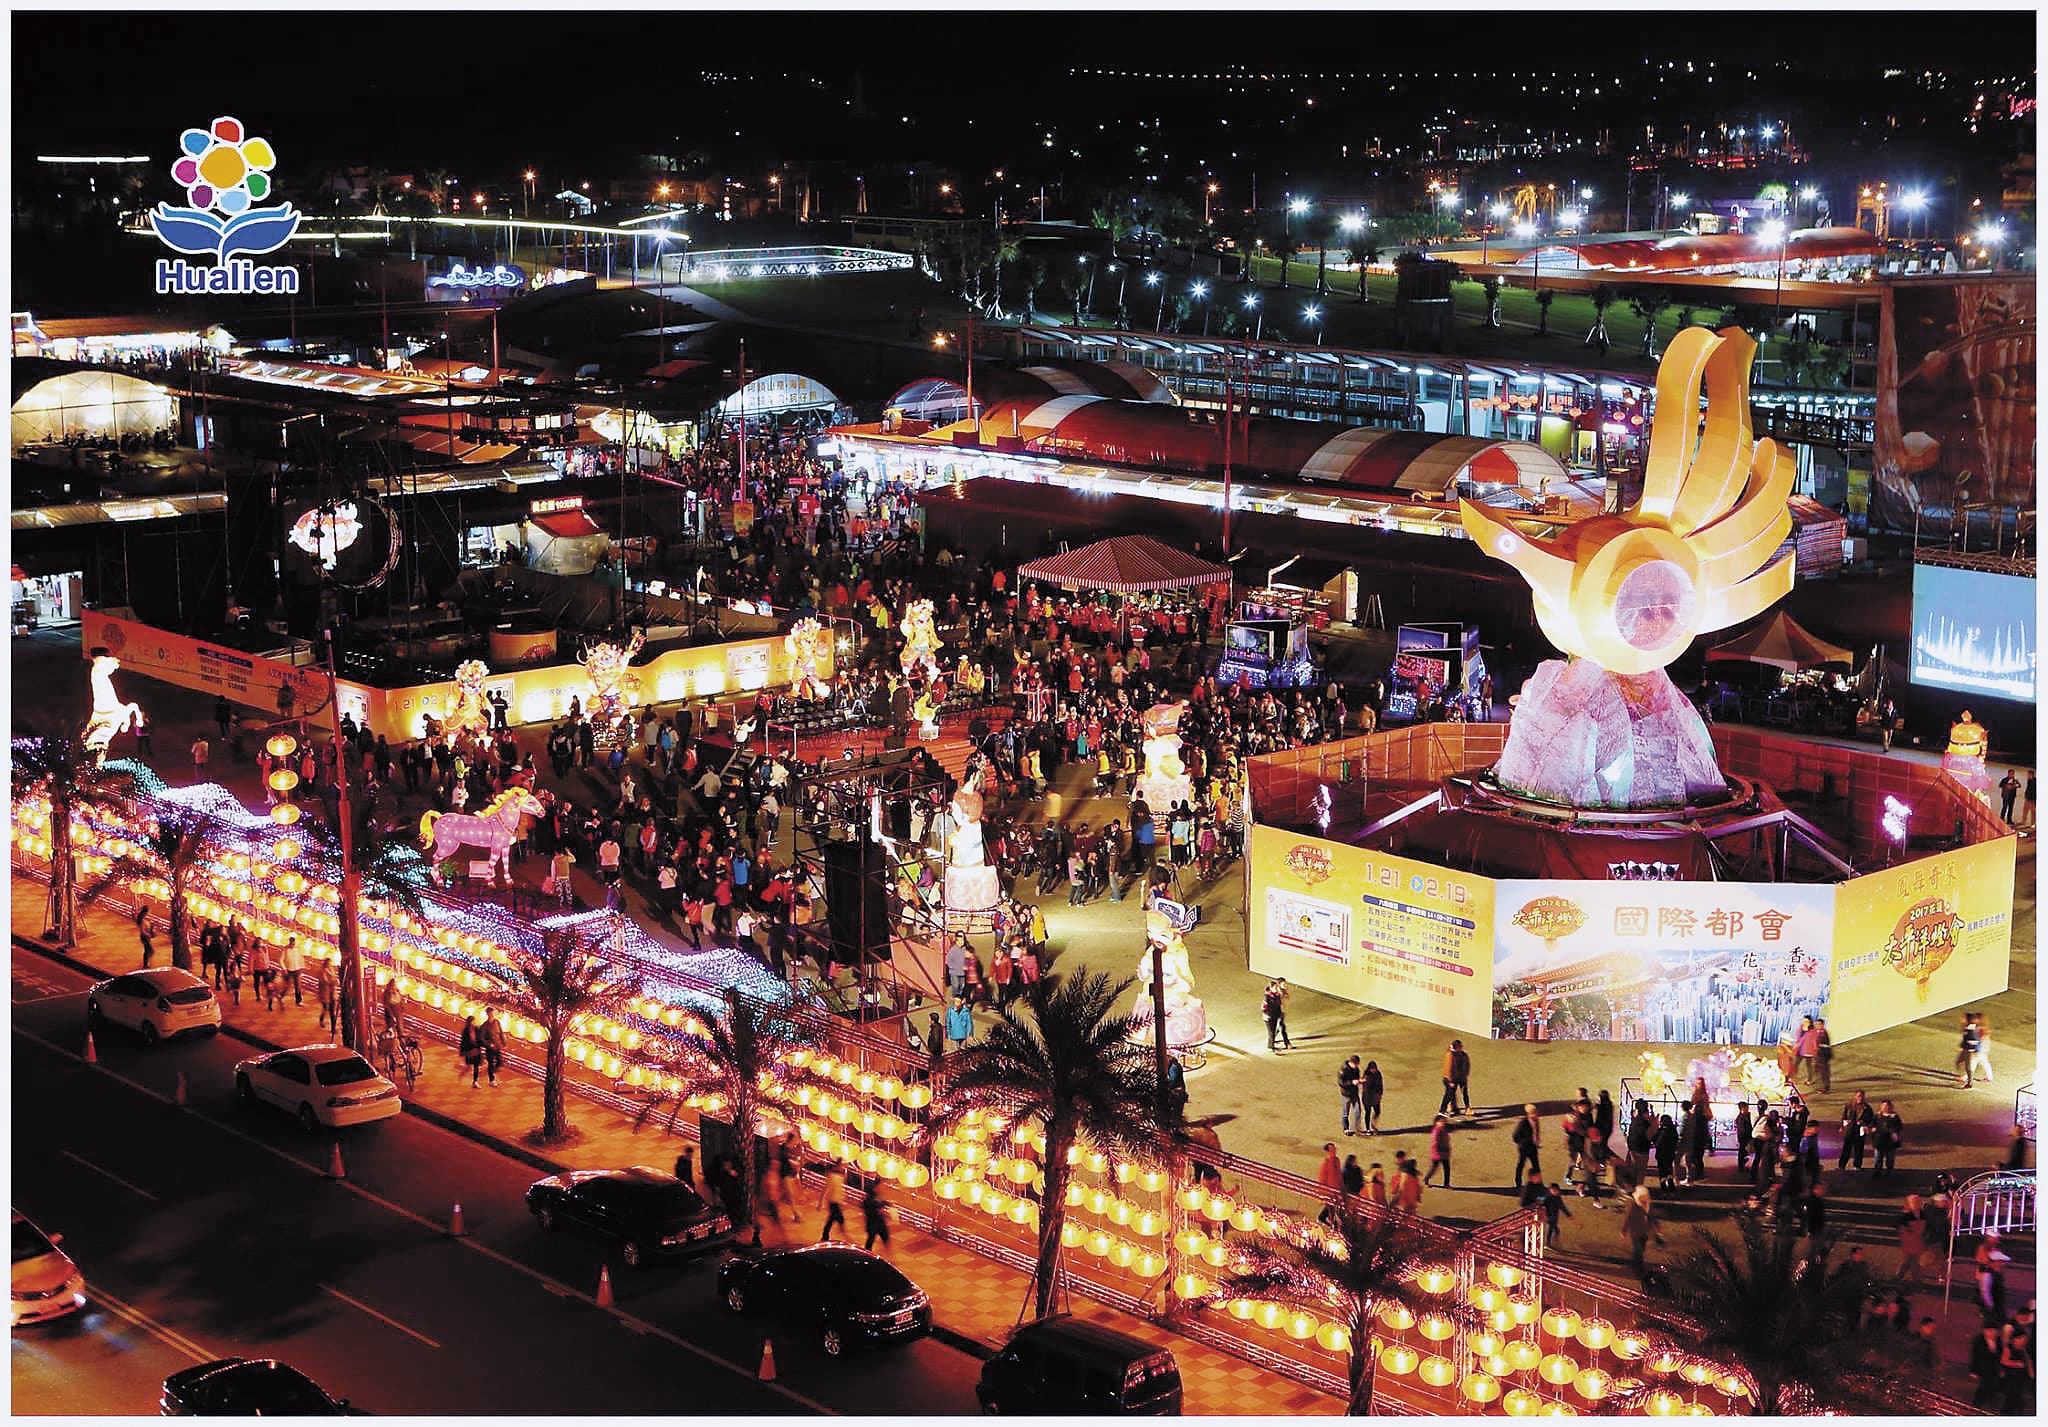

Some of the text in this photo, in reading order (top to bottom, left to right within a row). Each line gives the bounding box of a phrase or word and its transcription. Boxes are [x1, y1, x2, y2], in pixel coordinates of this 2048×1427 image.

[1366, 862, 1466, 904] 1.21 2.19
[1614, 906, 1793, 941] 國際都會
[1742, 951, 1766, 981] 花蓮
[1783, 946, 1806, 976] 香港
